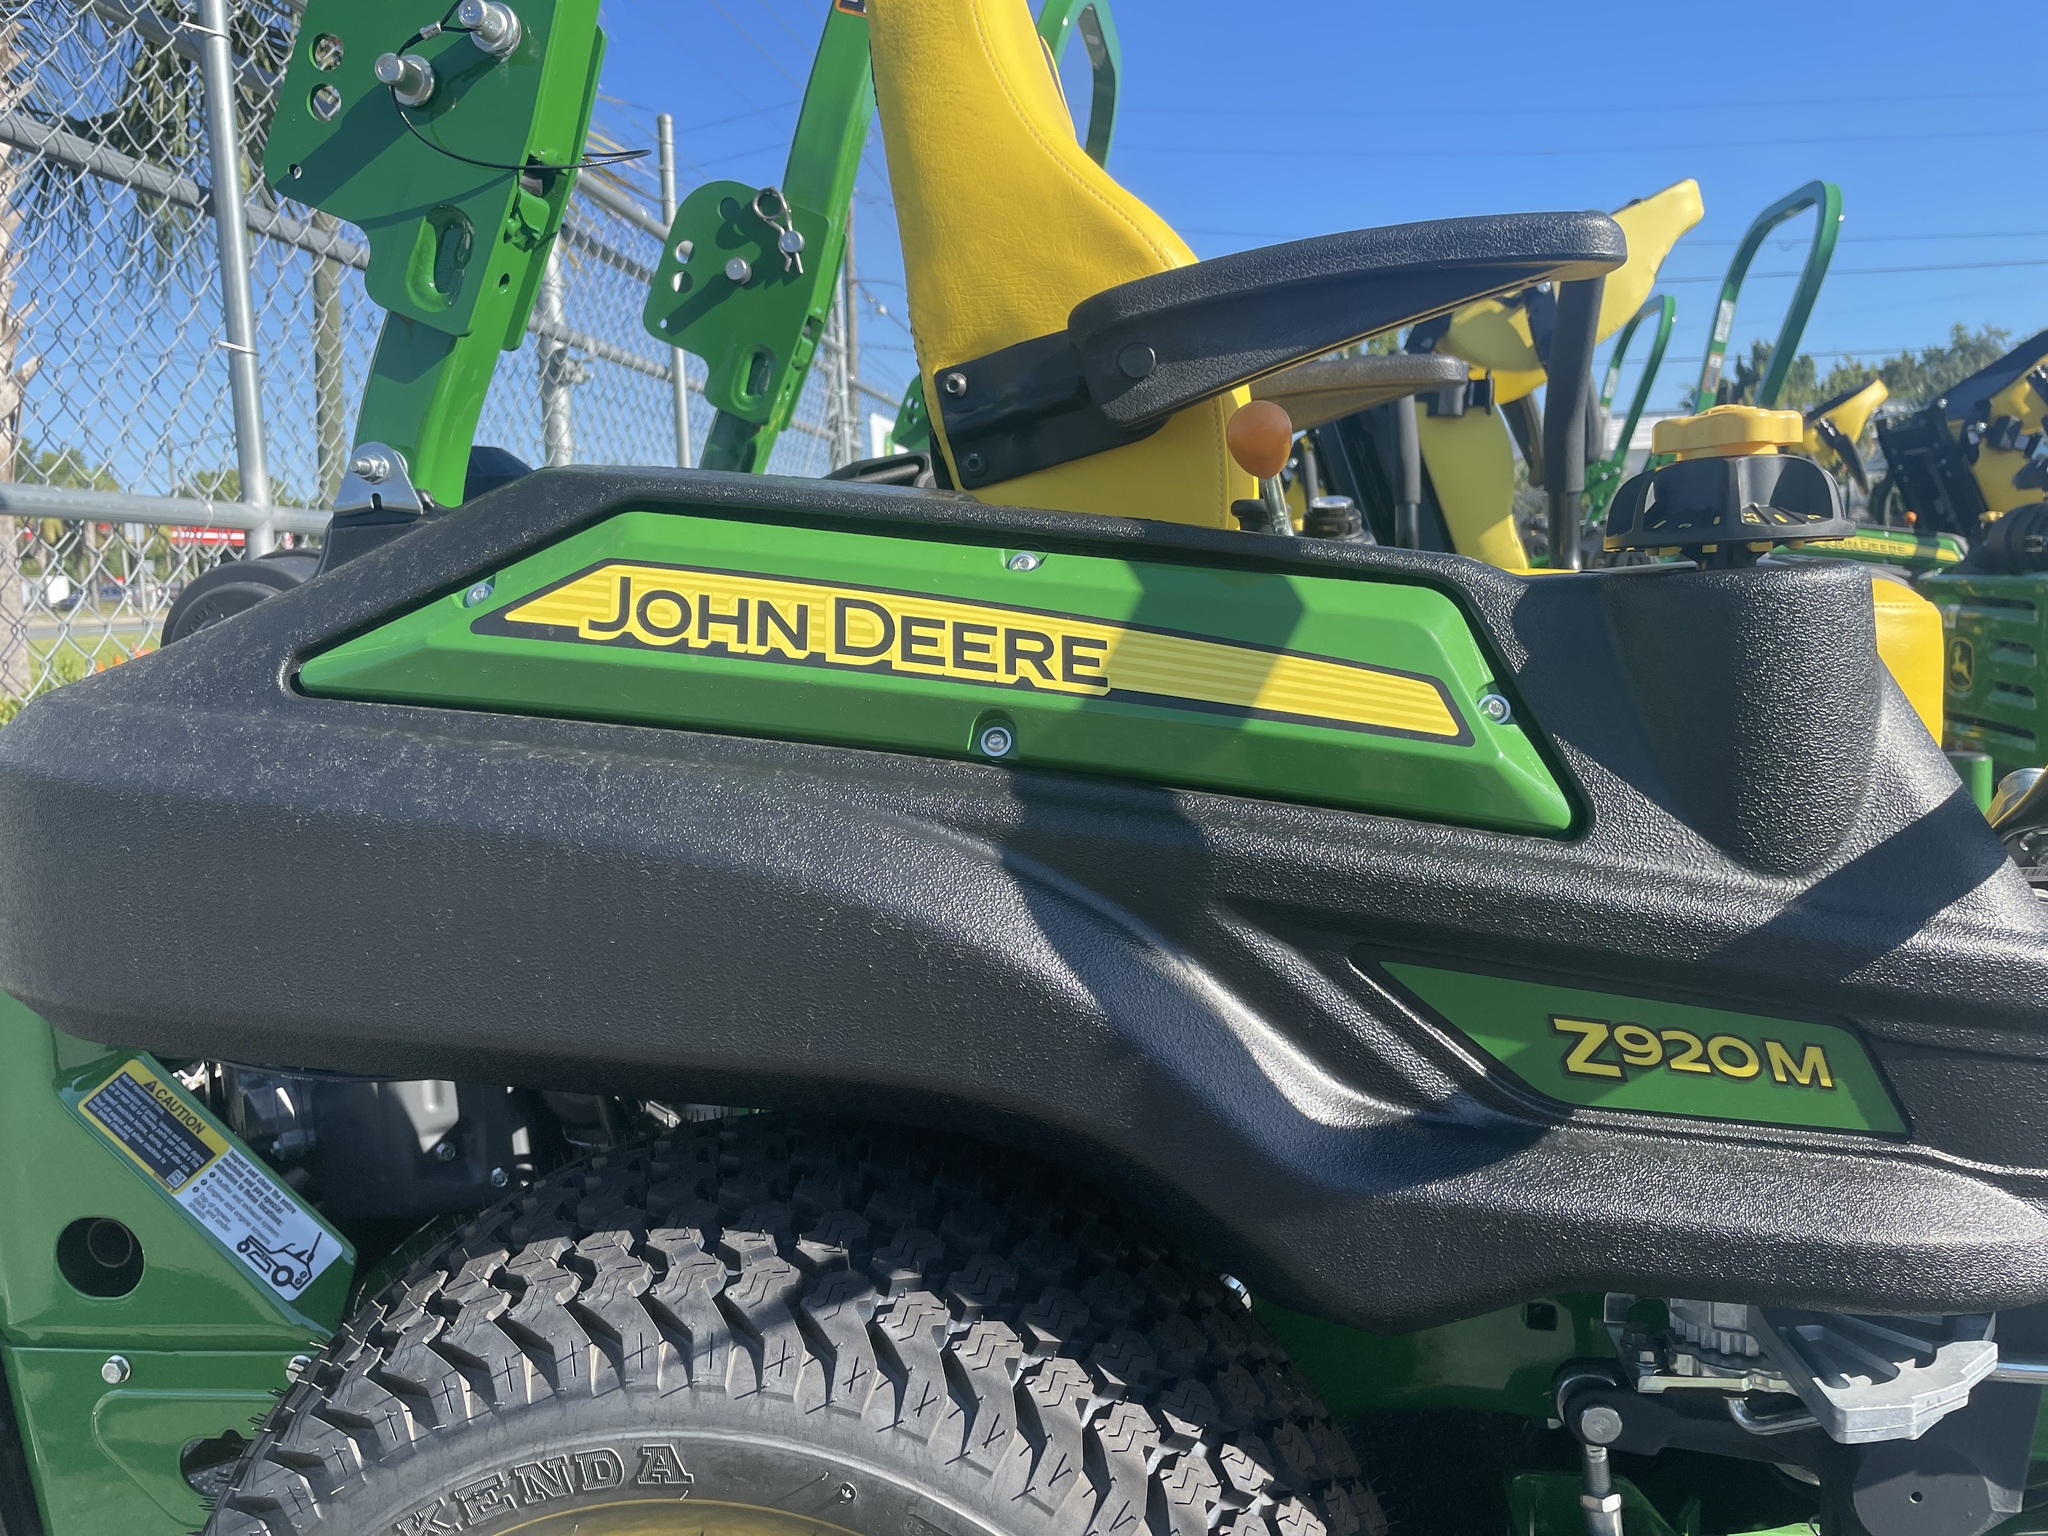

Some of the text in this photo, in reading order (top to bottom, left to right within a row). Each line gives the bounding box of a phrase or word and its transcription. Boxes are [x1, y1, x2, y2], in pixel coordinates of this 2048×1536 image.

[1860, 538, 1906, 555] DEERE
[582, 575, 1110, 690] JOHN DEERE
[1551, 1016, 1834, 1090] Z920M
[155, 1088, 206, 1134] CAUTION
[198, 1193, 209, 1203] Top
[214, 1207, 231, 1223] mower
[215, 1163, 238, 1184] attention
[244, 1189, 259, 1203] these
[222, 1157, 244, 1178] machine
[244, 1177, 255, 1187] and
[253, 1187, 264, 1197] pay
[264, 1195, 284, 1214] special
[228, 1151, 297, 1213] Inspect and clean the entire
[193, 1197, 231, 1232] deck and under
[206, 1185, 271, 1244] Engine and engine screens
[395, 1442, 696, 1536] KENDA
